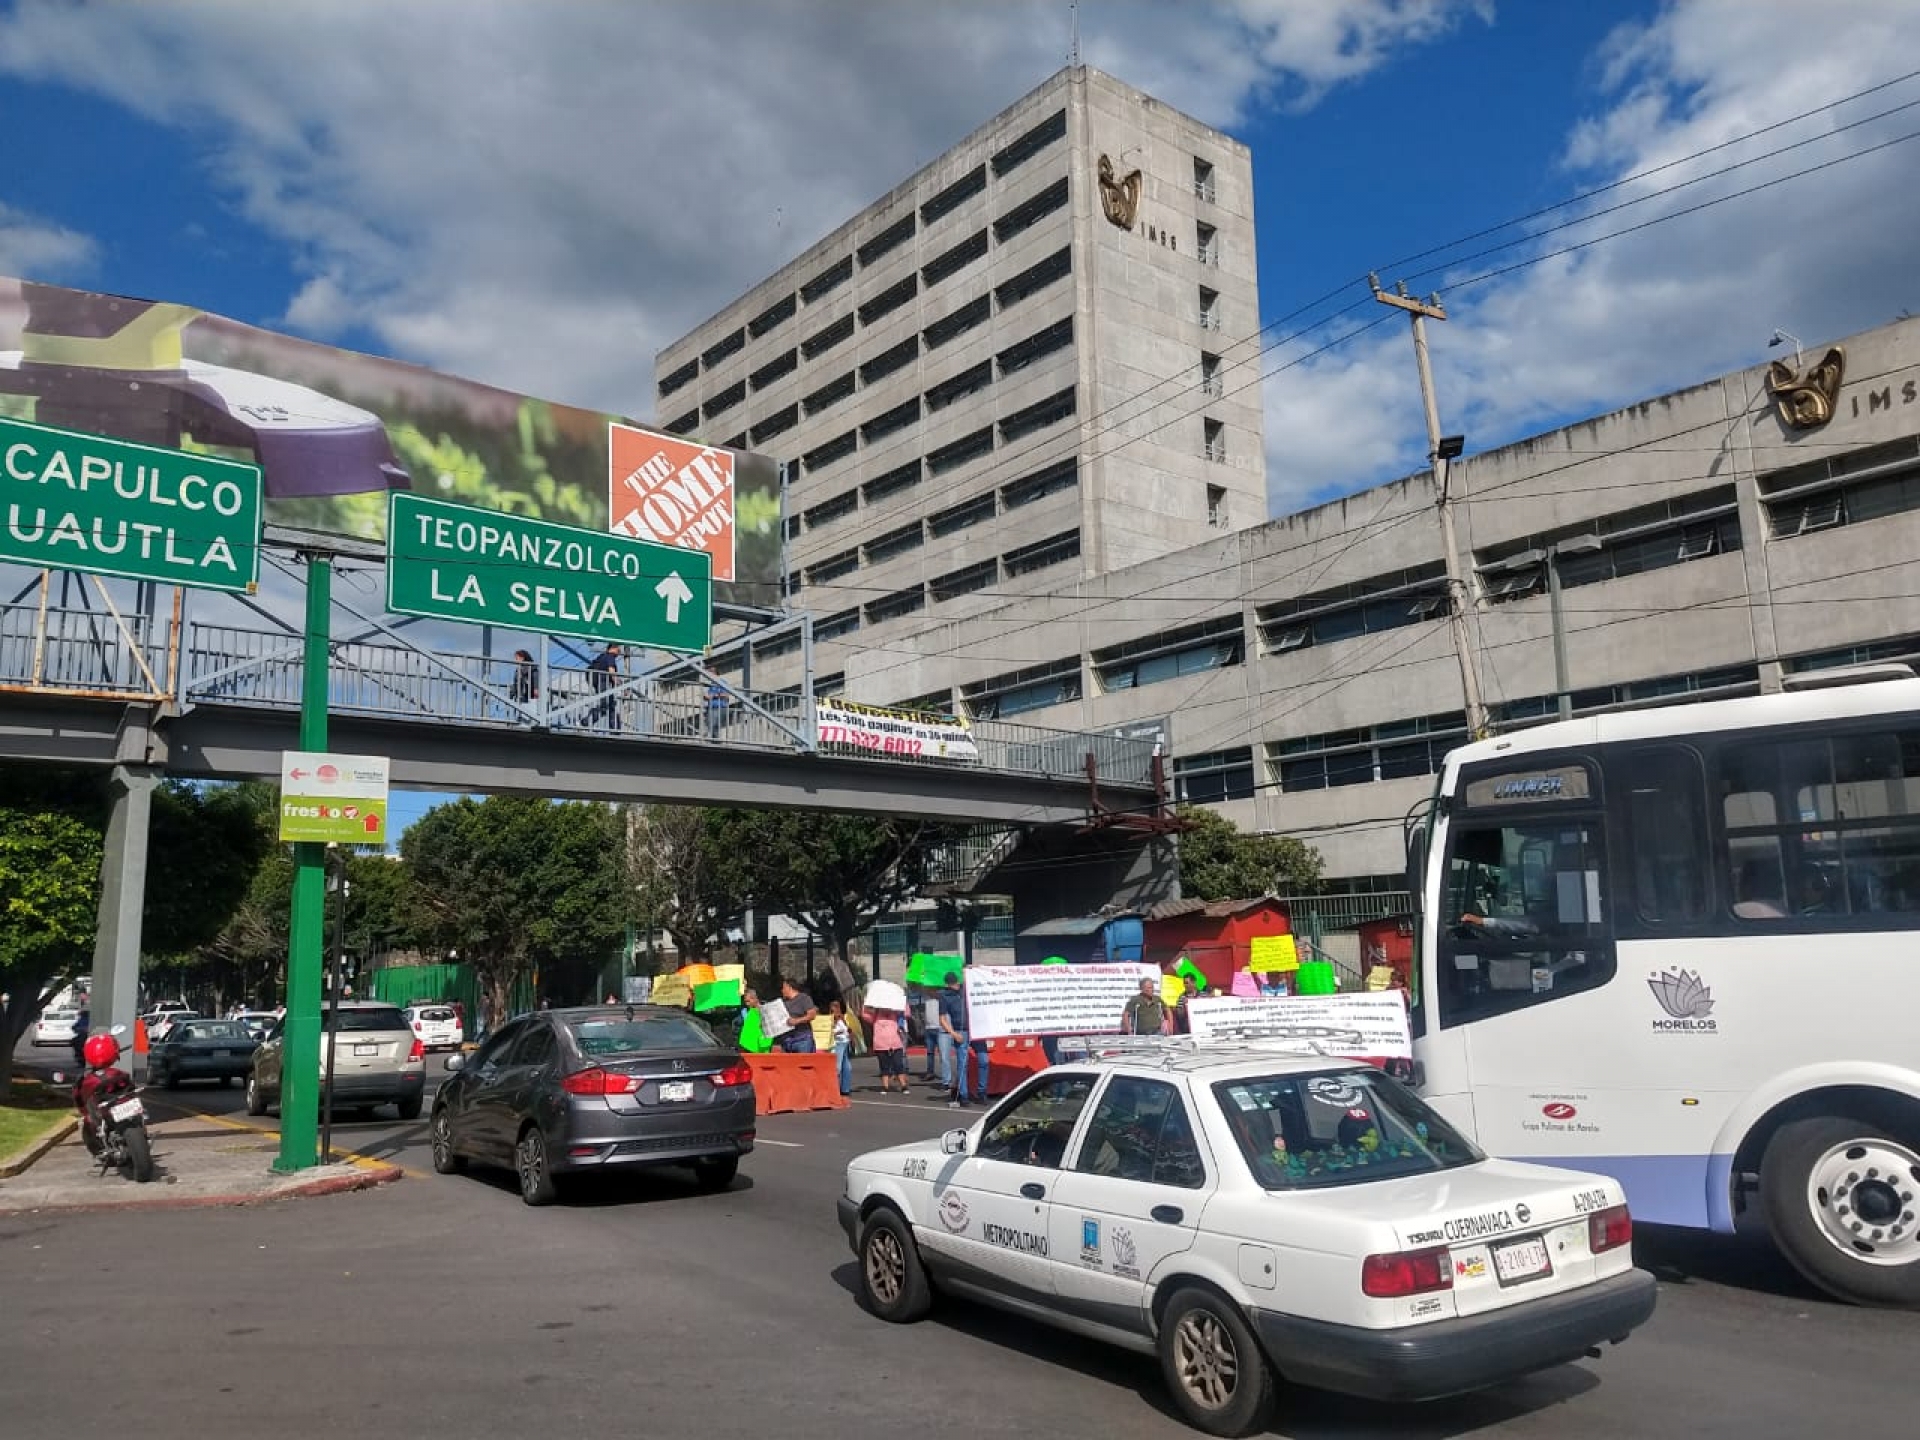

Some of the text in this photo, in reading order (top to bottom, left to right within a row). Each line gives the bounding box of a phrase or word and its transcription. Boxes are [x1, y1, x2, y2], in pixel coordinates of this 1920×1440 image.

[1851, 380, 1919, 418] IMS
[0, 443, 243, 516] CAPULCO
[623, 450, 676, 498] THE
[8, 503, 238, 572] UAUTLA
[415, 513, 640, 581] TEOPANZOLCO
[431, 569, 621, 627] LA SELVA
[851, 730, 880, 750] 532
[884, 736, 922, 758] 6012
[284, 803, 340, 818] fresko
[1652, 1019, 1717, 1030] MORELOS
[983, 1221, 1048, 1257] METROPOLITANO
[1444, 1210, 1513, 1241] CUERNAVACA
